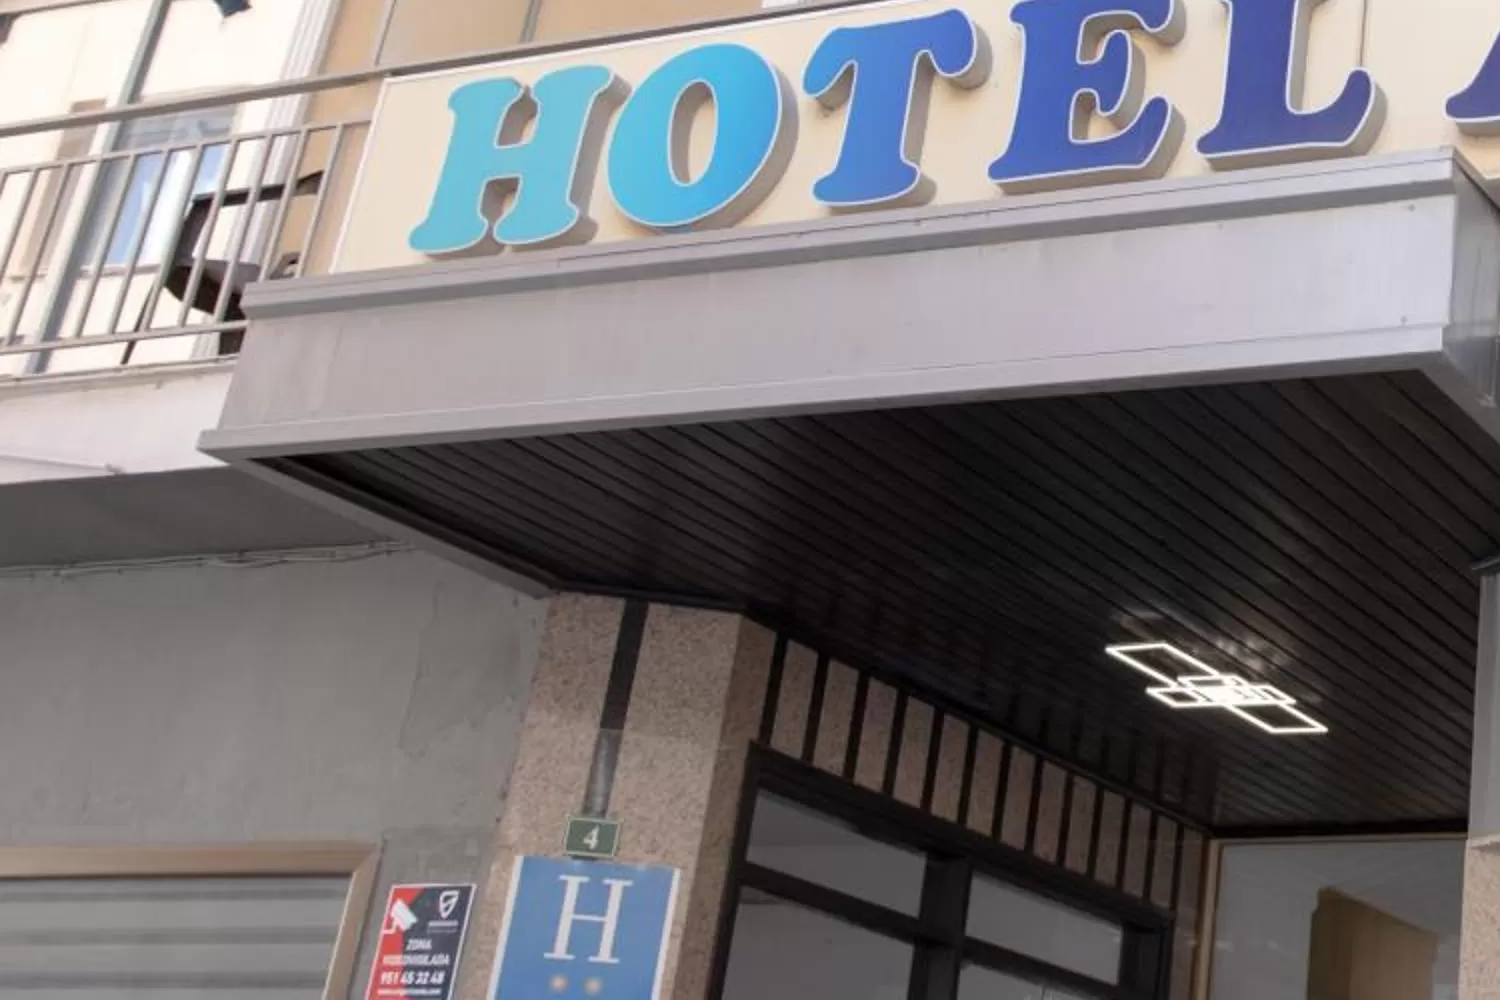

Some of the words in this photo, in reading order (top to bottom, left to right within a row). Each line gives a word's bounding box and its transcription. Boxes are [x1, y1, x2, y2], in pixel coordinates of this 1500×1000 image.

[582, 826, 600, 850] 4
[543, 874, 634, 964] H
[406, 938, 432, 951] ZONA
